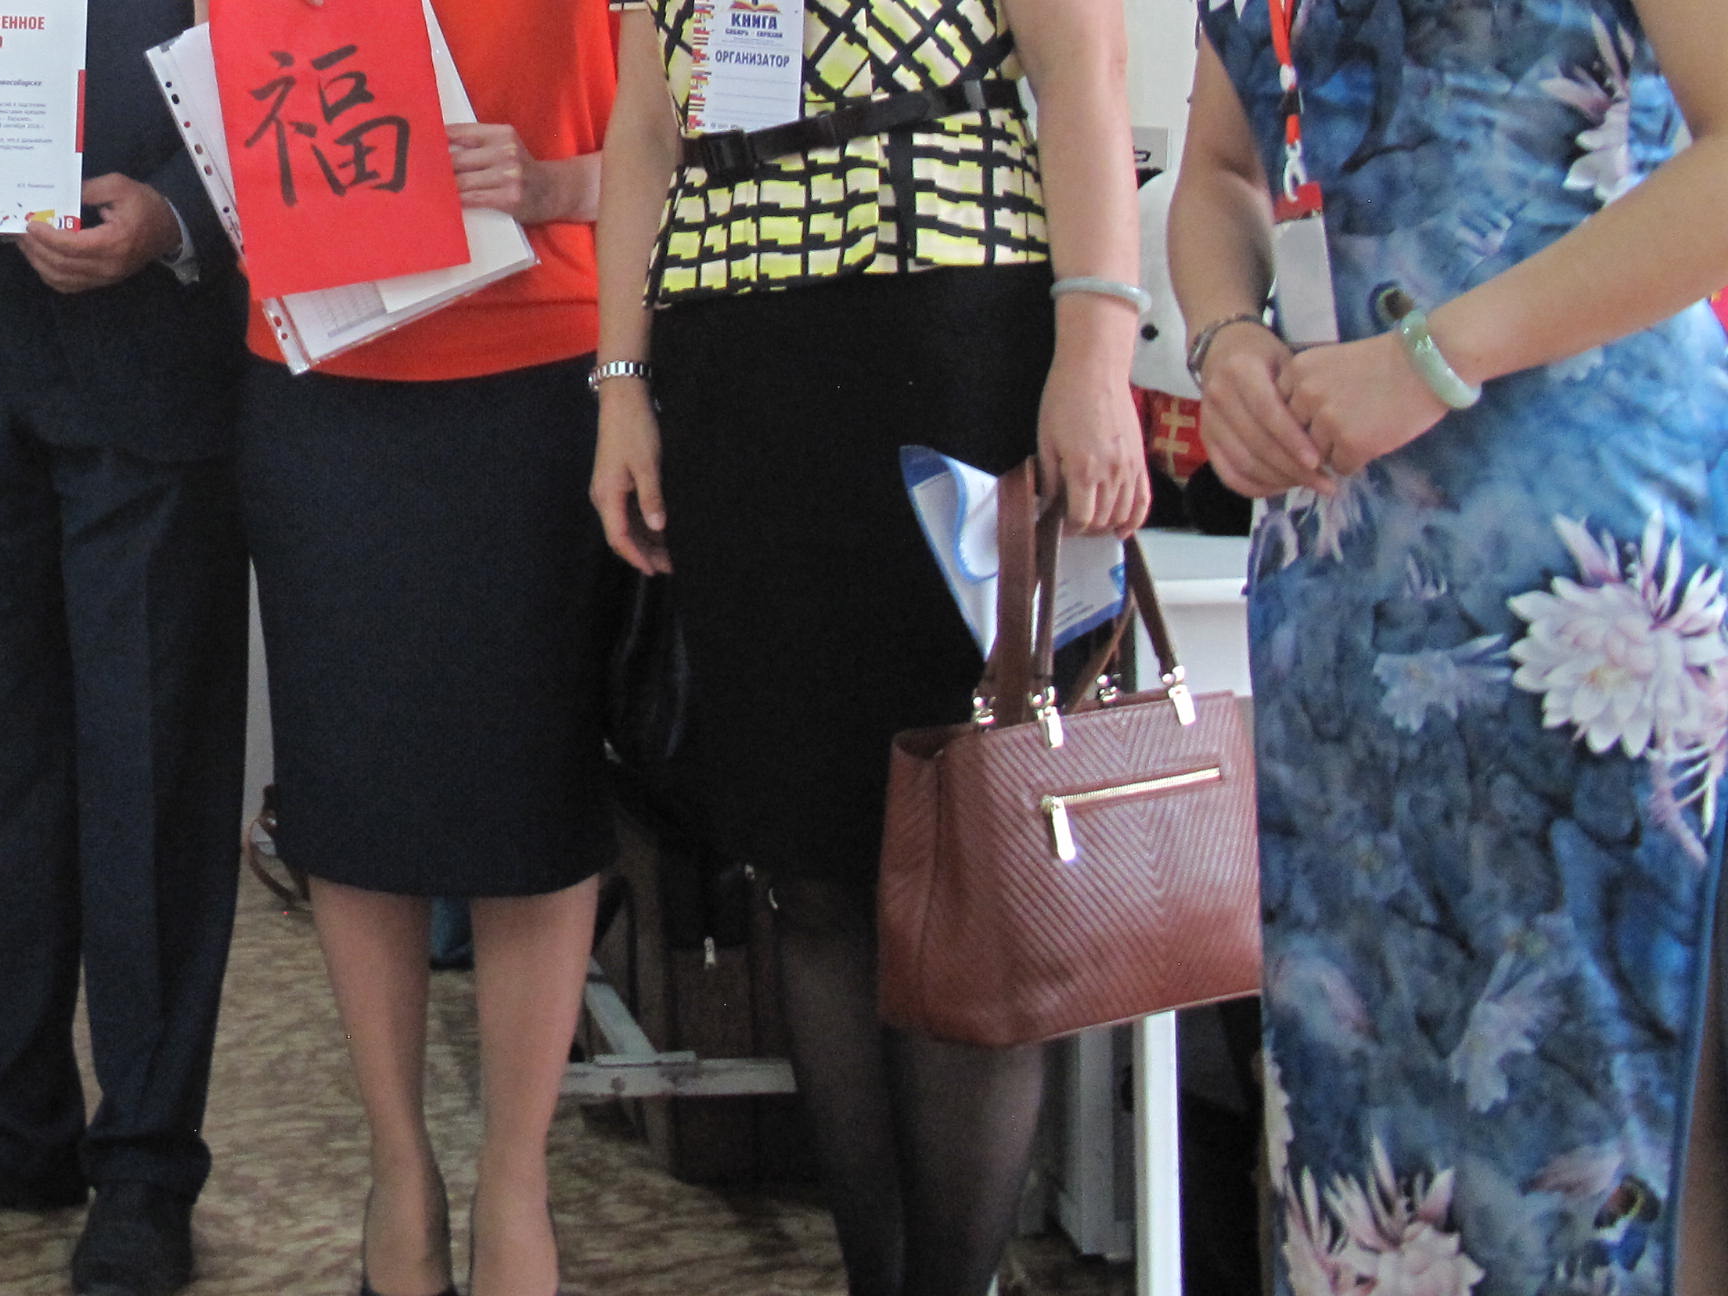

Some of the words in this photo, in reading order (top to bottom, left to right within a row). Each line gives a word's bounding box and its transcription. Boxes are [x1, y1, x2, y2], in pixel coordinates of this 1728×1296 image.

[731, 13, 778, 30] КНИГА
[715, 49, 790, 68] ОРГАНИЗАТОР
[244, 44, 410, 207] 福
